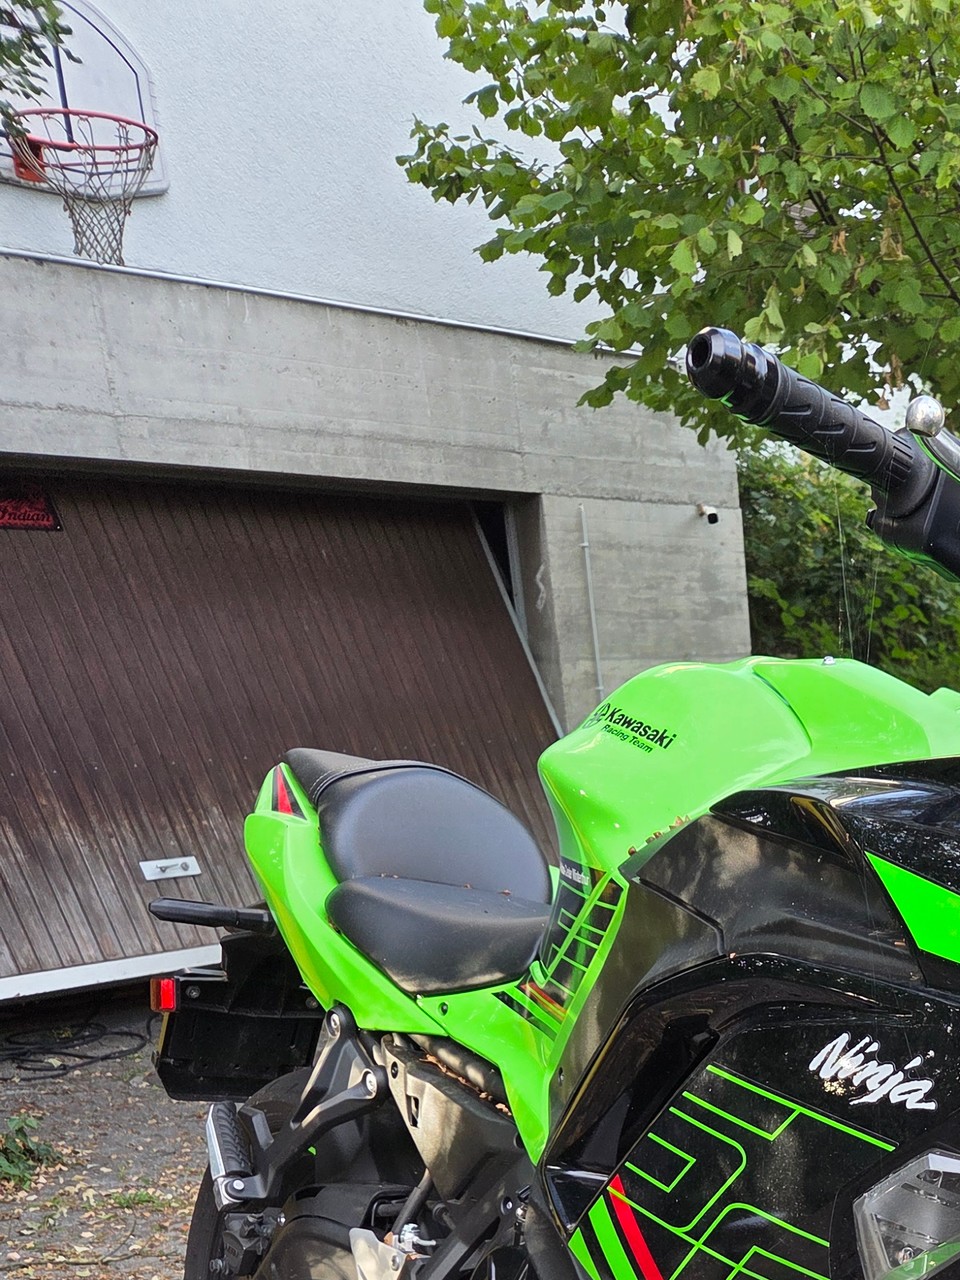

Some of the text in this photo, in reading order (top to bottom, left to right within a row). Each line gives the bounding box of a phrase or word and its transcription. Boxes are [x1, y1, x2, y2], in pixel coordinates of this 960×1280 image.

[600, 724, 653, 754] Racing Team
[606, 707, 677, 750] Kawasaki
[808, 1031, 938, 1111] Ninja
